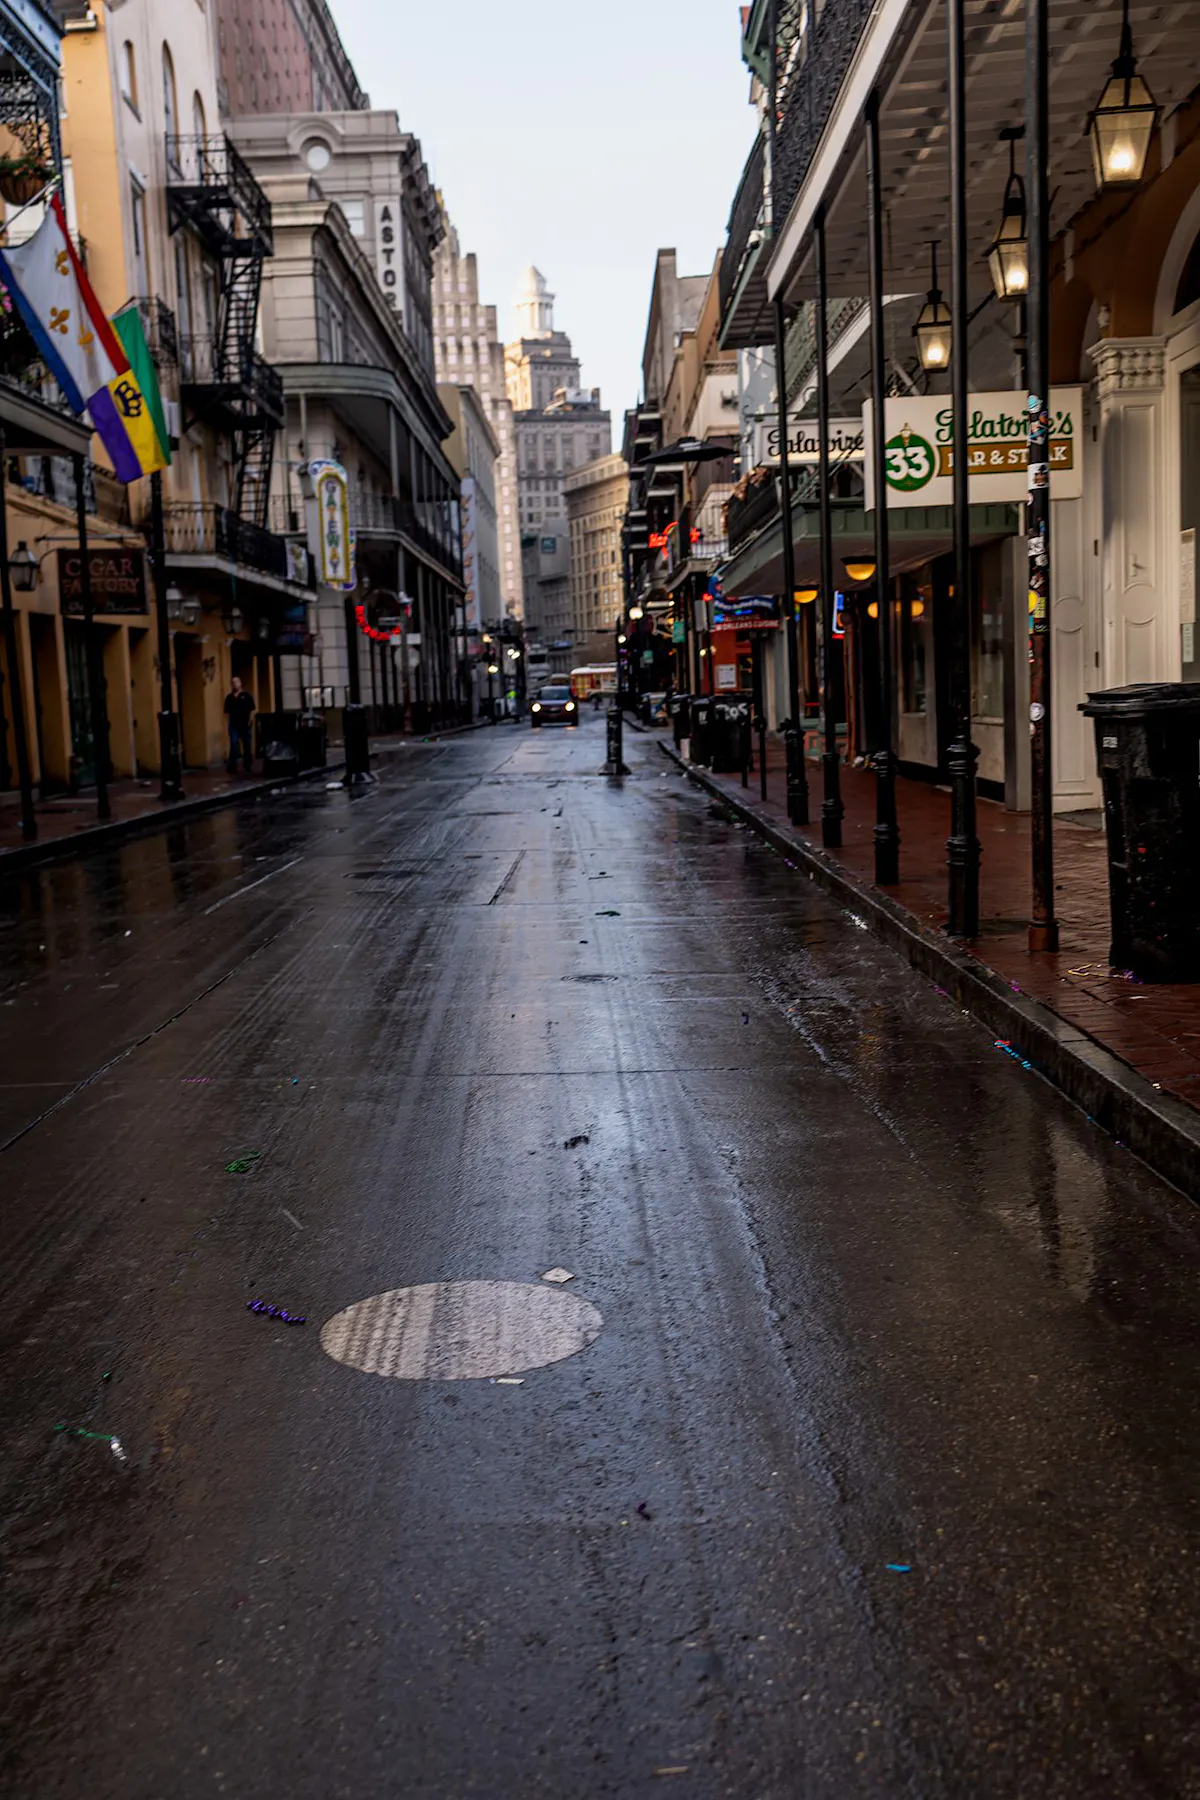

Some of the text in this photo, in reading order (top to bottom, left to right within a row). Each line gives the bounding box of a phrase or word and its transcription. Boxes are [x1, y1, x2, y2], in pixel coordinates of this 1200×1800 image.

[380, 205, 397, 308] ASTOR
[935, 409, 1073, 443] Glatoie's
[767, 429, 864, 457] Galaoire
[990, 449, 1005, 465] &
[1008, 446, 1069, 465] STK
[885, 447, 931, 481] 33
[64, 557, 135, 577] CGAR
[61, 577, 142, 598] FATORY
